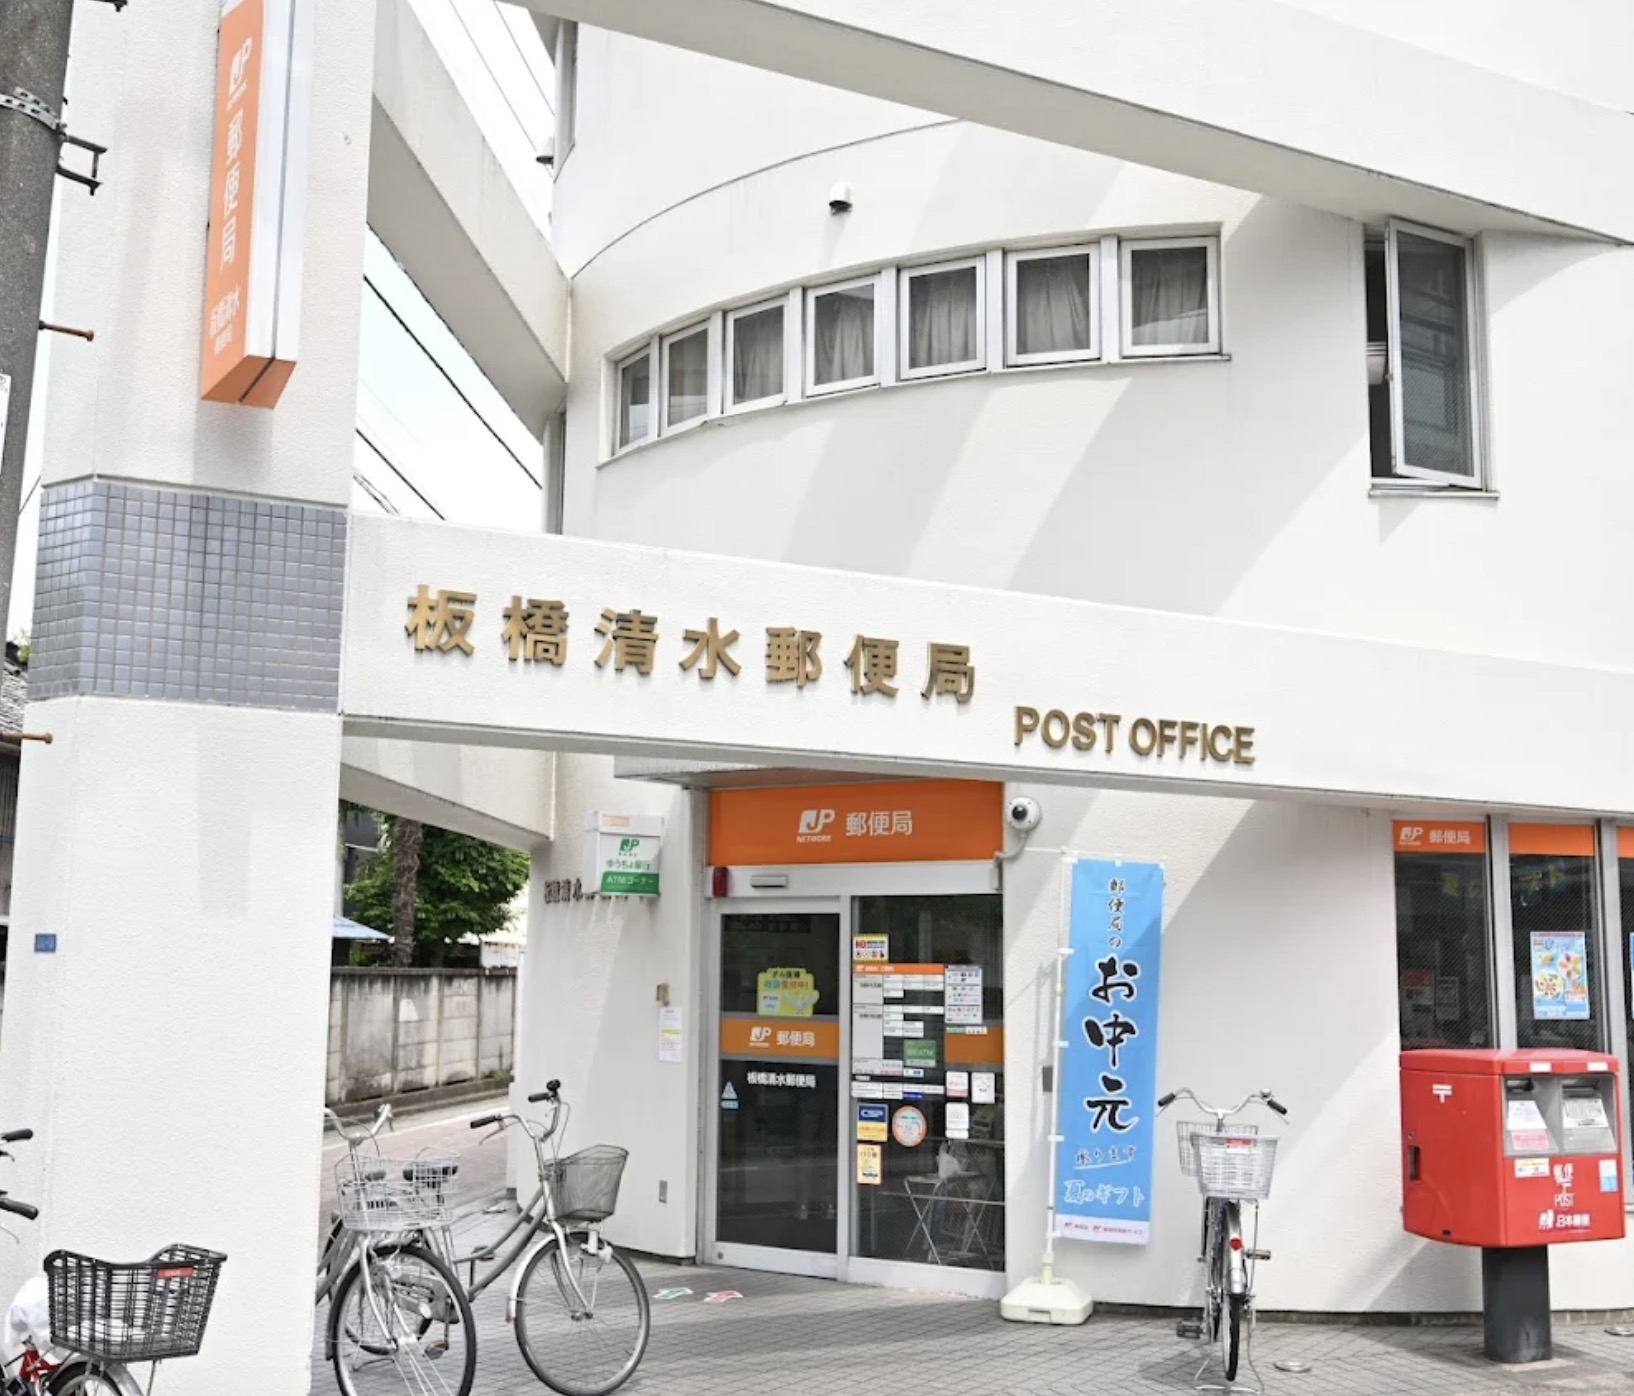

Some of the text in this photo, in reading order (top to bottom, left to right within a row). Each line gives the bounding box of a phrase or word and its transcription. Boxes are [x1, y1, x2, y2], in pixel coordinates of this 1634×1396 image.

[220, 108, 243, 273] 郵便局
[404, 583, 976, 704] 板橋清水郵便局
[1014, 706, 1255, 764] POST OFFICE
[799, 809, 912, 836] JP 郵便局
[1400, 826, 1470, 845] JP 郵便局
[619, 838, 640, 852] JP
[1108, 878, 1124, 948] 郵便局の
[750, 1026, 816, 1048] JP 郵便局
[1084, 955, 1140, 1132] お中元
[747, 1071, 816, 1089] 板橋清水郵便局
[1064, 1180, 1146, 1208] 夏のギフト
